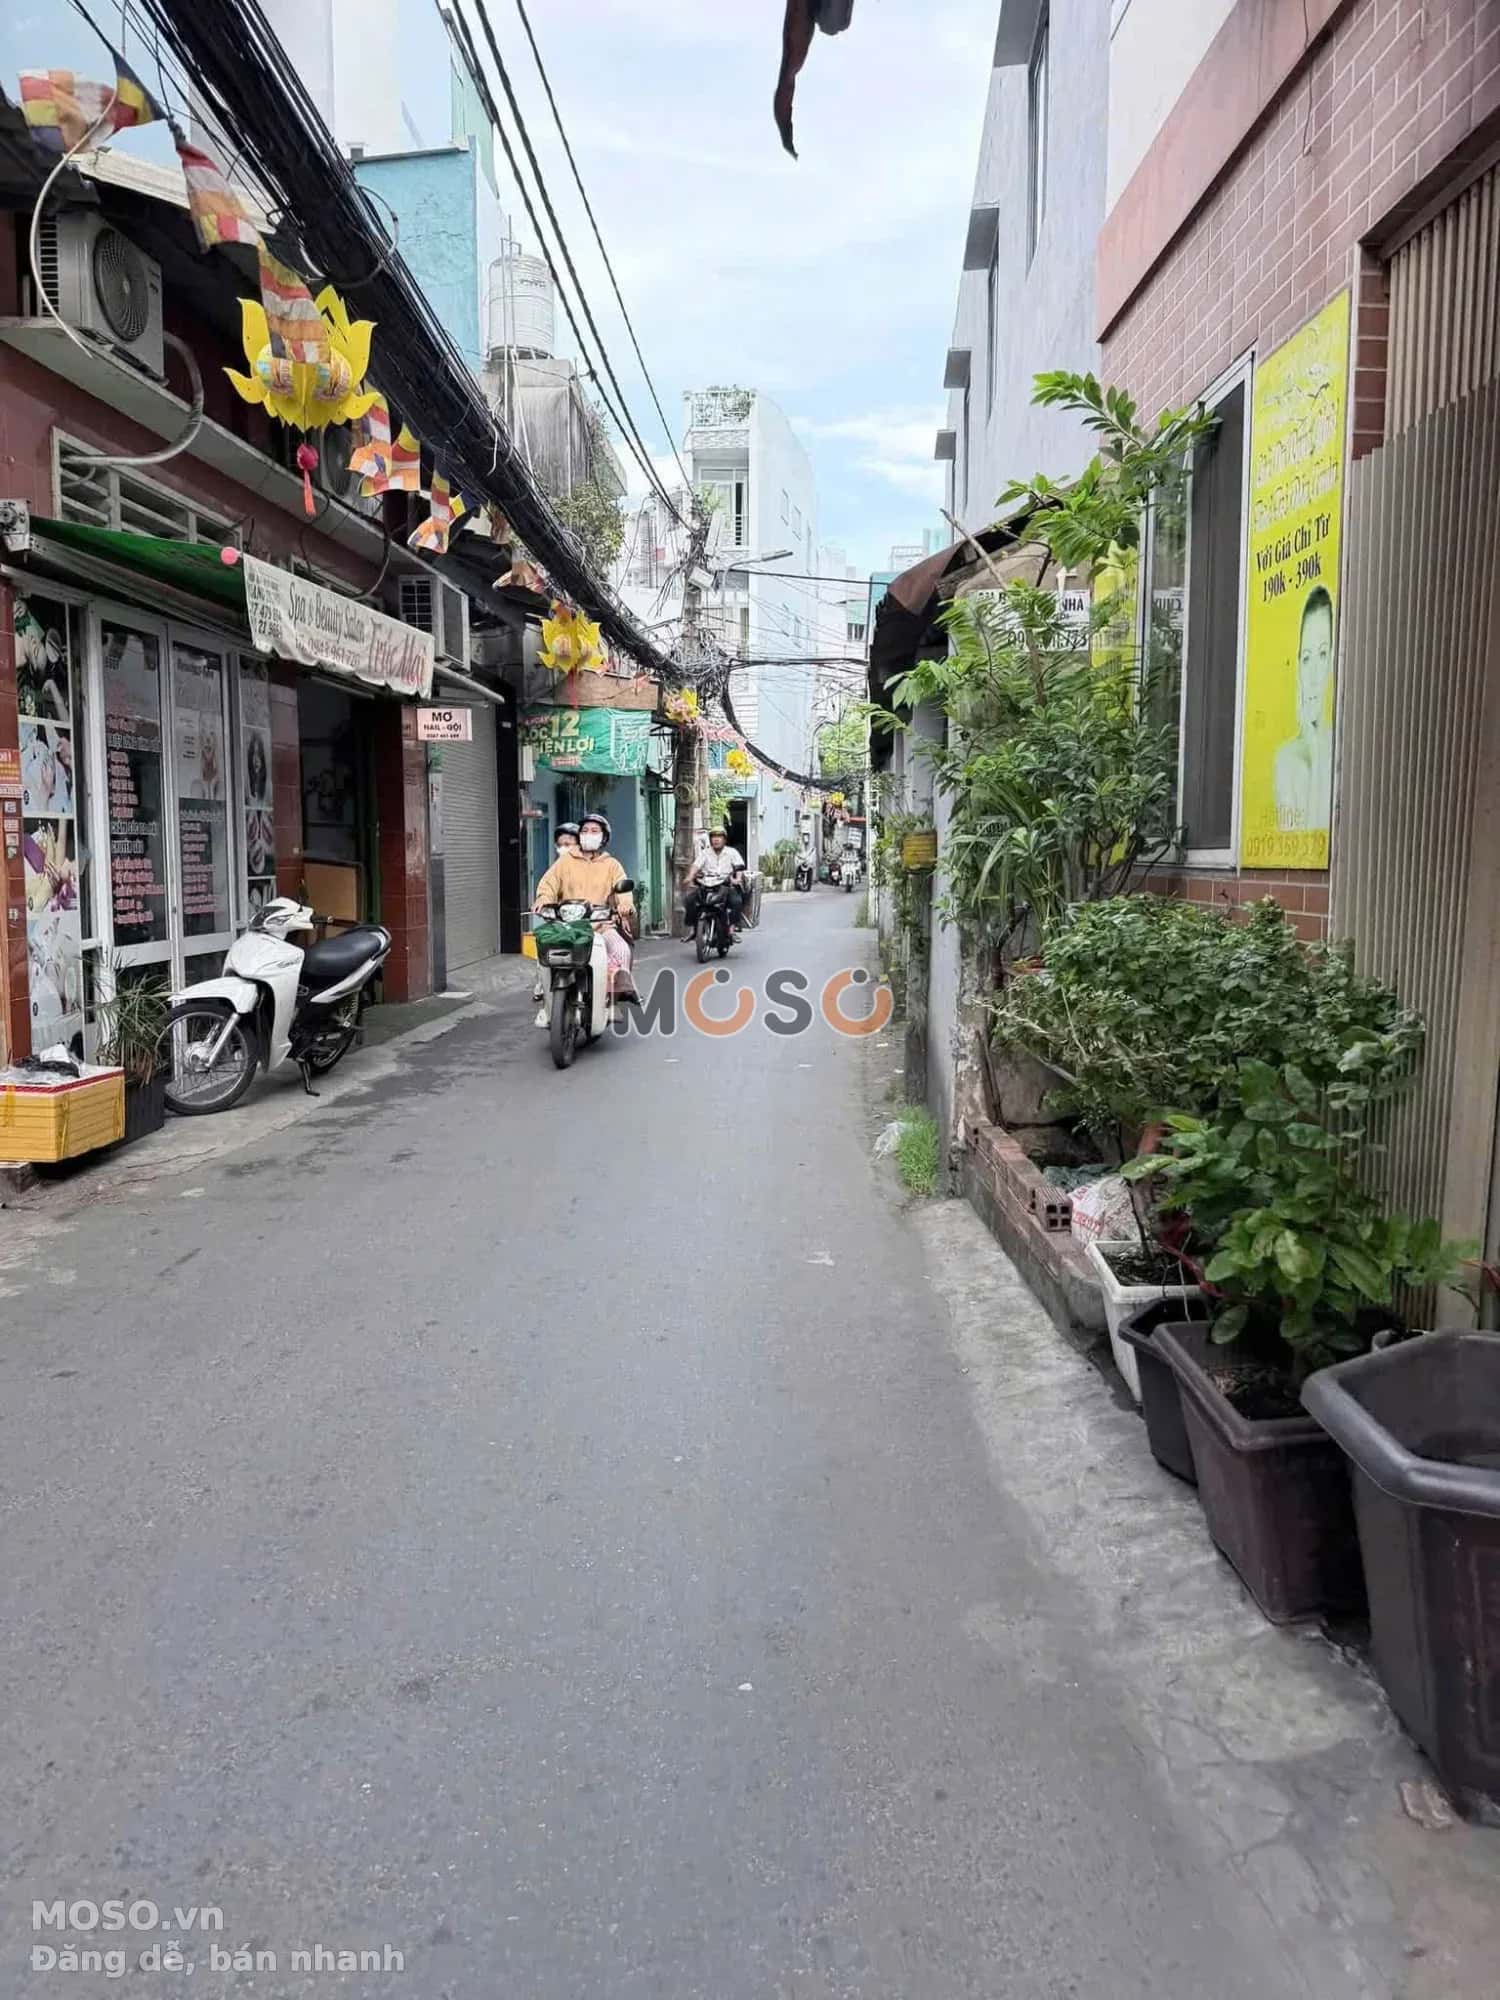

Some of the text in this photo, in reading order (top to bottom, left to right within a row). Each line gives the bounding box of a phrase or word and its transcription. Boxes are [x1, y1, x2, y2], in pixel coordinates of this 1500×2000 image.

[1257, 544, 1272, 573] Với
[1275, 532, 1291, 563] Giá
[1314, 512, 1331, 541] Từ
[1263, 570, 1286, 602] 190k
[1295, 551, 1321, 589] 390k
[288, 582, 306, 625] Spa
[550, 710, 580, 737] 12
